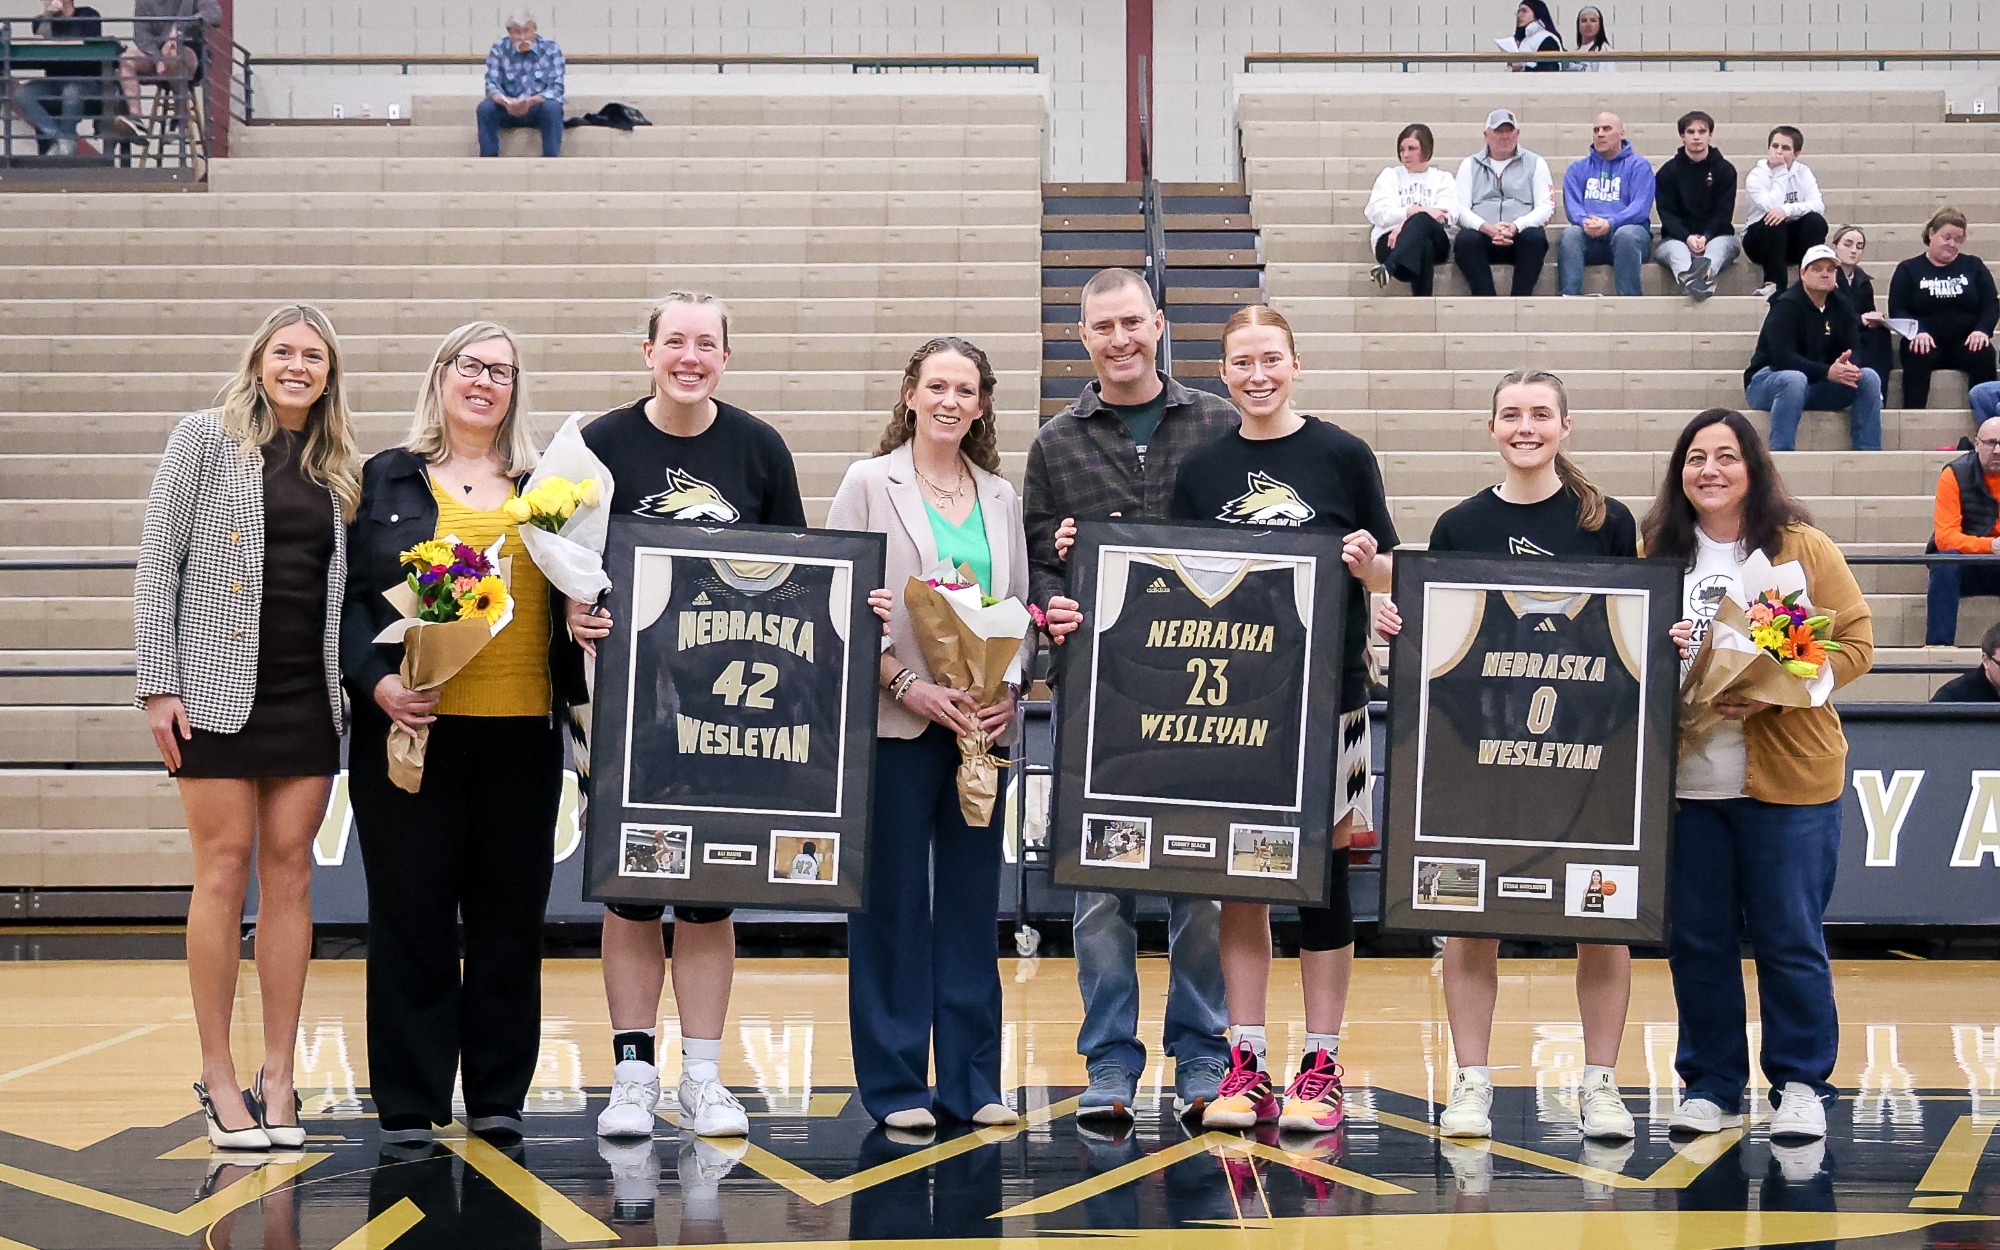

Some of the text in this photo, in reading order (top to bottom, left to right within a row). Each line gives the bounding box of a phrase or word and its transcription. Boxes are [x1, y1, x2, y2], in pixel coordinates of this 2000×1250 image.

[1584, 189, 1620, 202] HOUSE
[678, 611, 814, 663] NEBRASKA
[1145, 620, 1274, 652] NEBRASKA
[712, 661, 778, 709] 42
[1186, 658, 1229, 705] 23
[1482, 652, 1606, 681] NEBRASKA
[1526, 686, 1557, 734] 0
[677, 713, 809, 763] WESLEYAN
[1141, 714, 1268, 746] WESLEYAN
[1478, 740, 1602, 769] WESLEYAN
